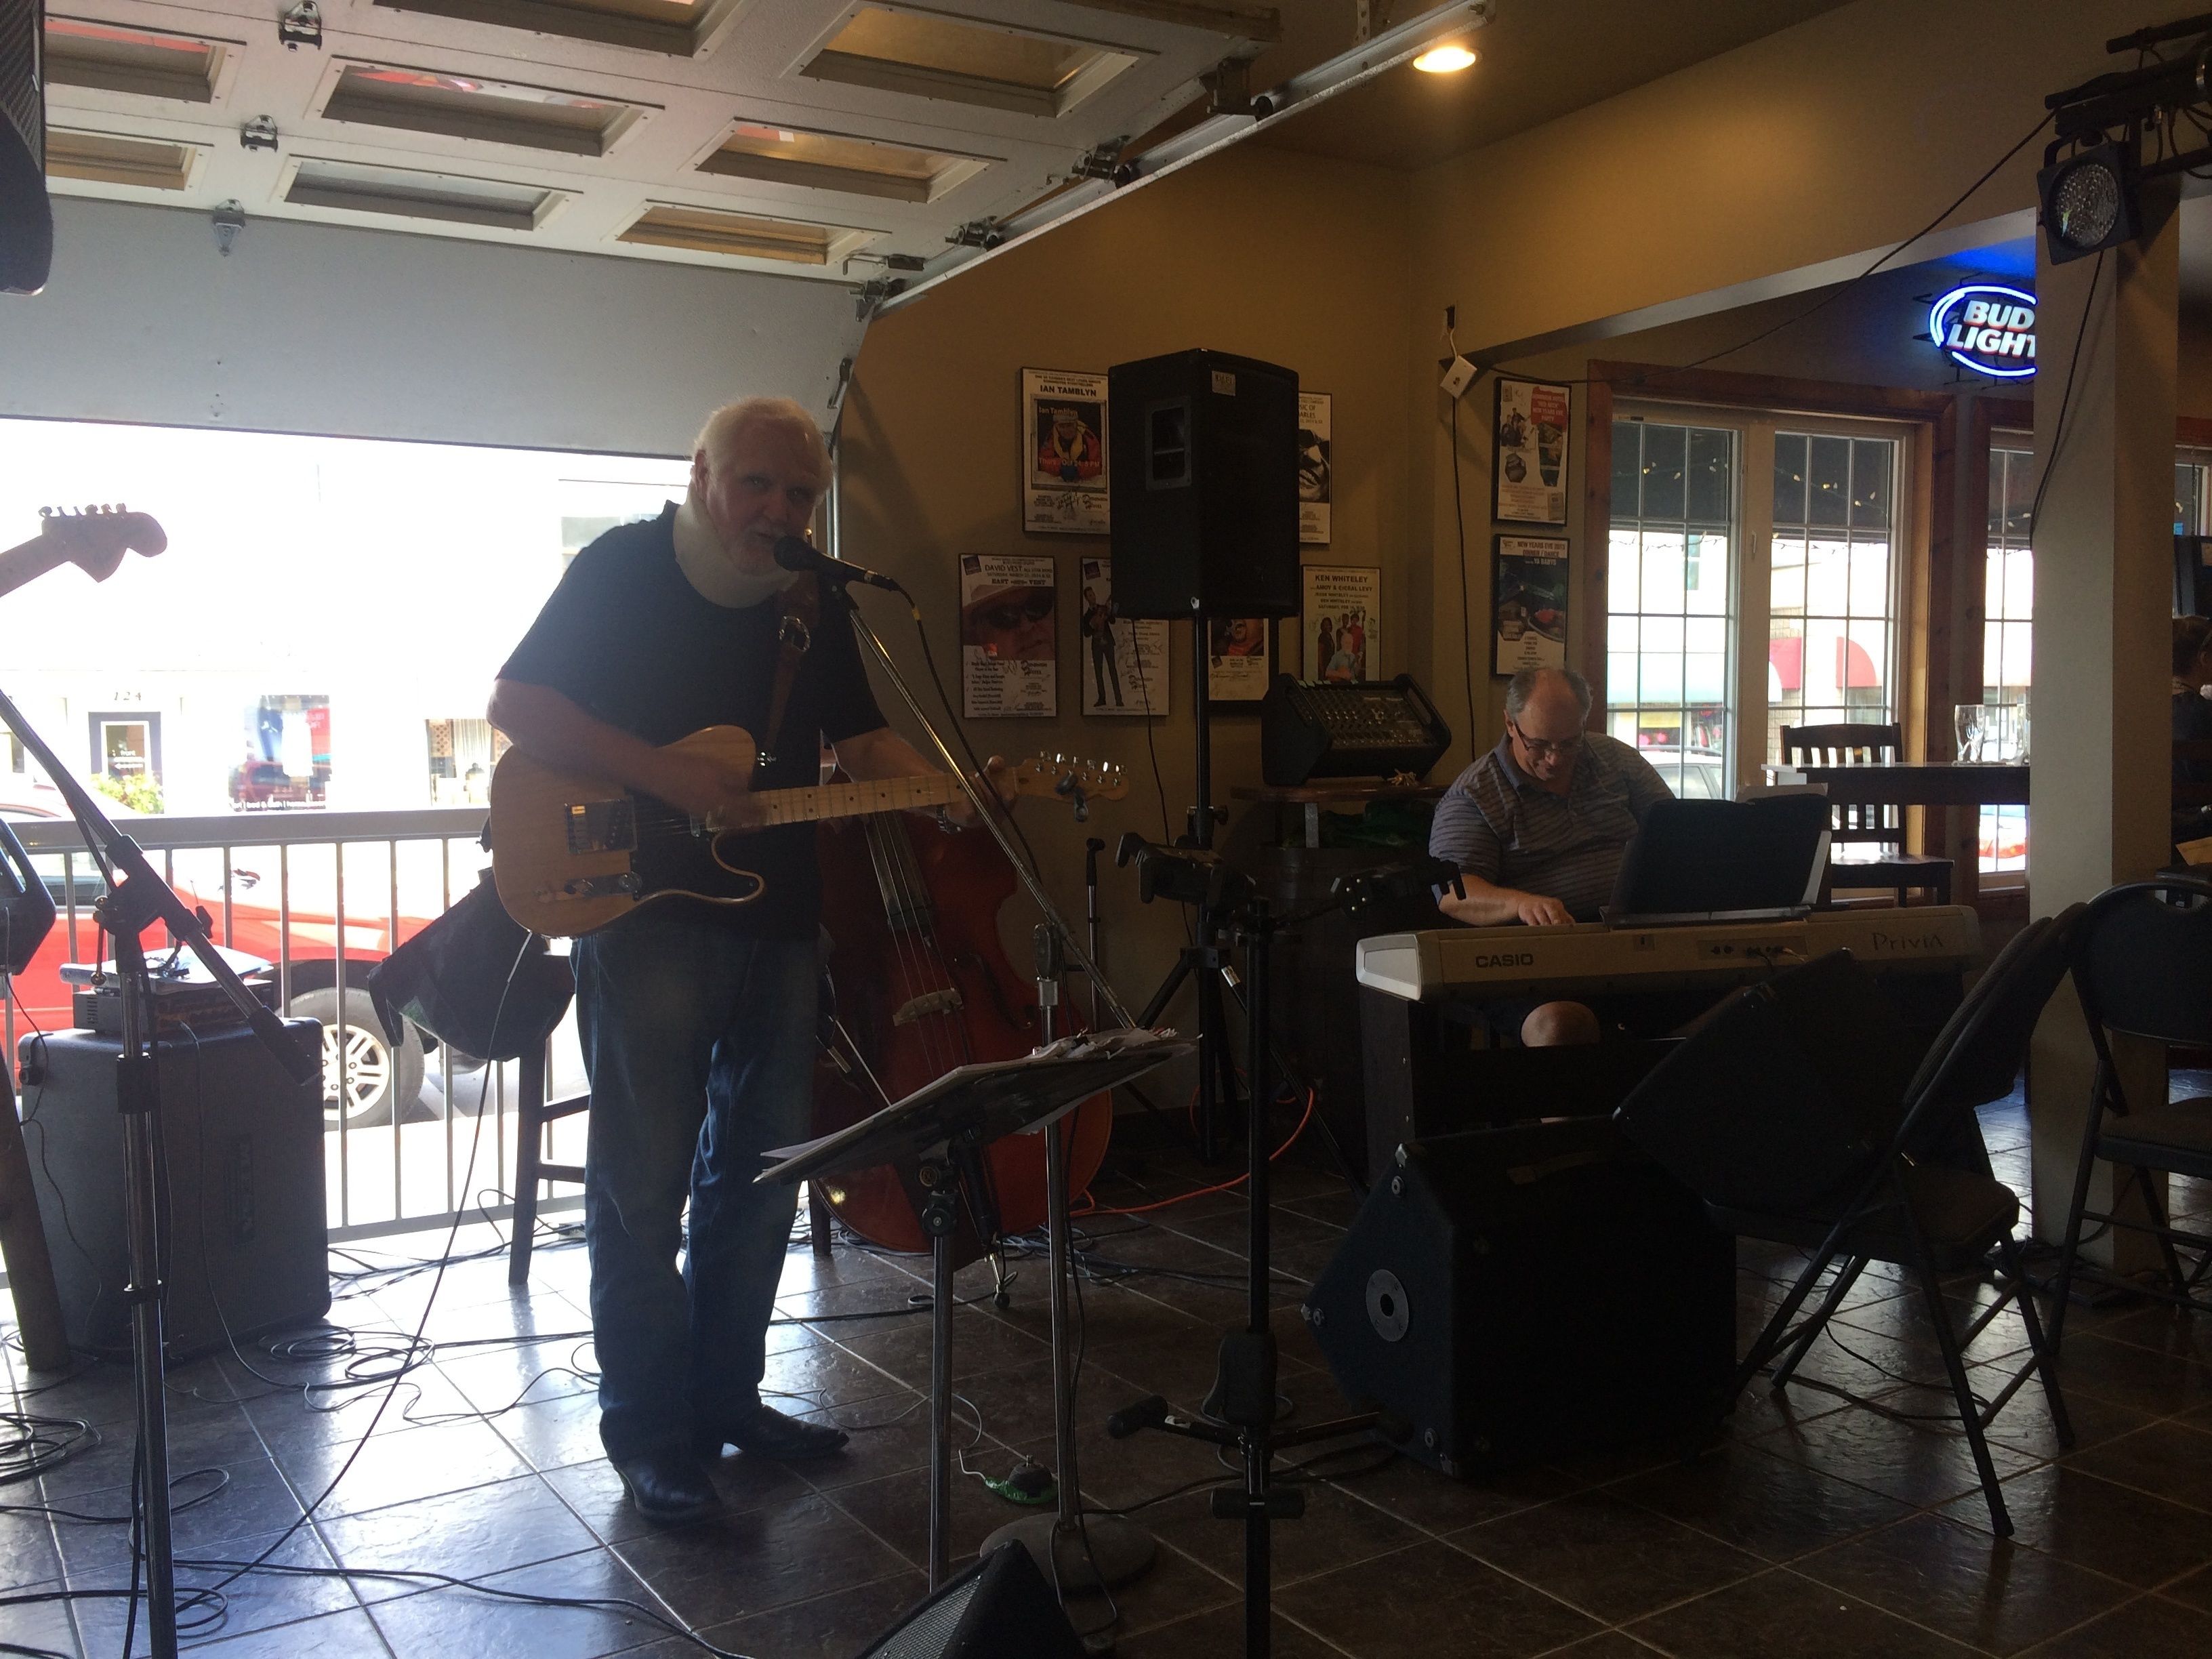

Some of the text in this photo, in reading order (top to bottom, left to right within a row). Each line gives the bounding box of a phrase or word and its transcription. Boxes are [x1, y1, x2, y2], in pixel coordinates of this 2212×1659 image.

[1963, 300, 2035, 332] BUD
[1040, 385, 1097, 396] IAN TAMBLYN
[1050, 407, 1079, 417] Tamblyn
[114, 691, 141, 701] 124
[1475, 953, 1534, 968] CASIO
